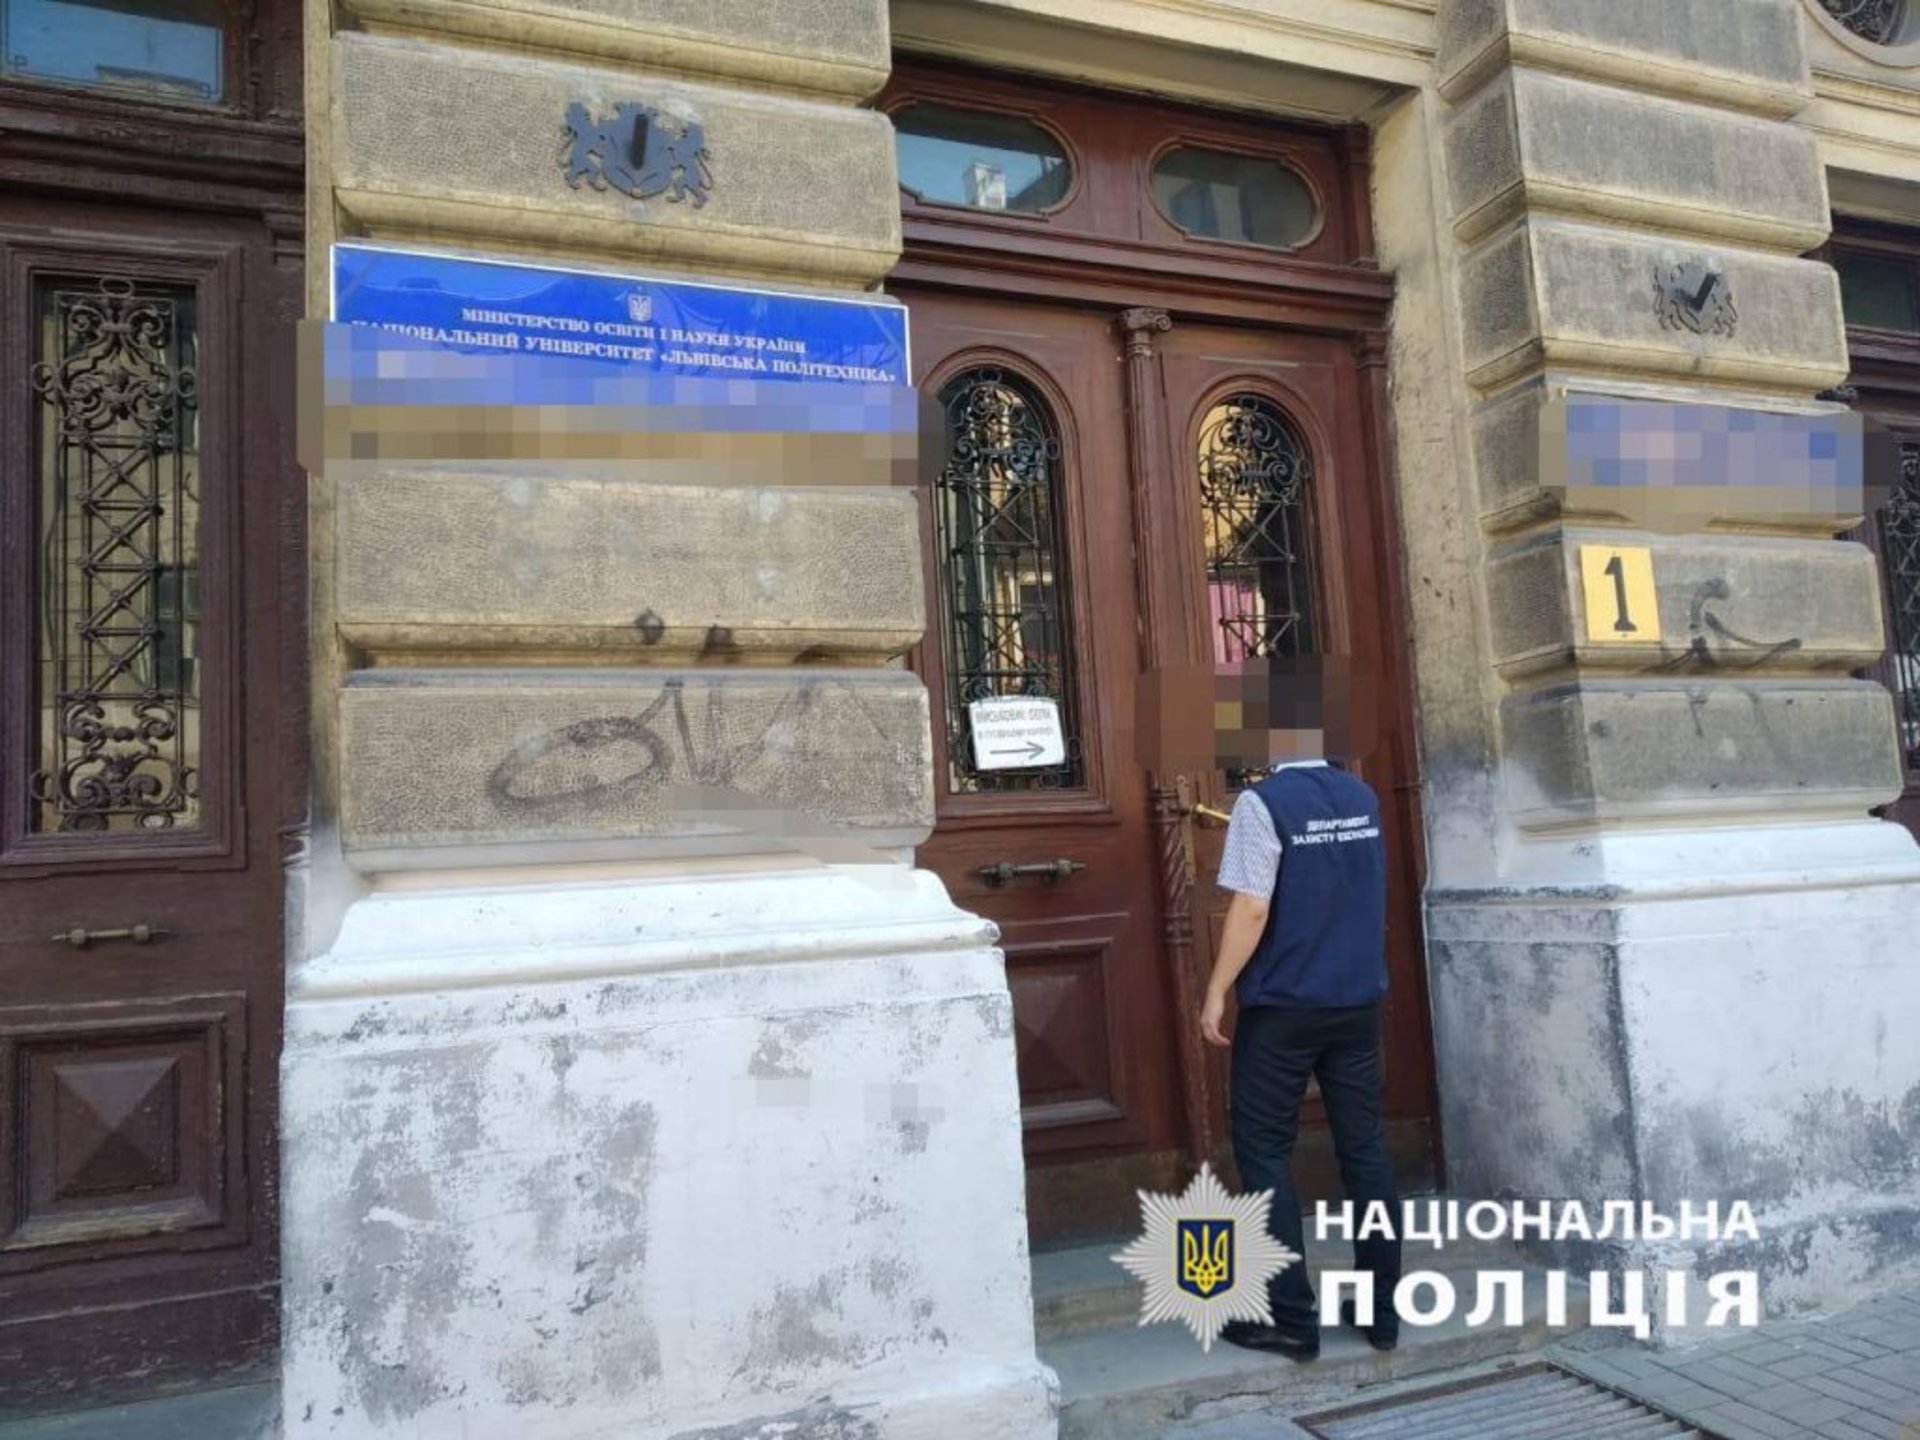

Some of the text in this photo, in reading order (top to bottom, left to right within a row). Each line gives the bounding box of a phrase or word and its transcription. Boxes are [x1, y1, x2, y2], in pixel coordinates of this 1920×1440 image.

[351, 320, 519, 349] ІОНАЛЬНИЙ
[525, 336, 654, 362] УНІВЕРСИТЕТ
[462, 308, 806, 354] МІНІСТЕРСТВО ОСВІТИ І НАУКИ УКРАЇНИ
[1604, 556, 1638, 632] 1
